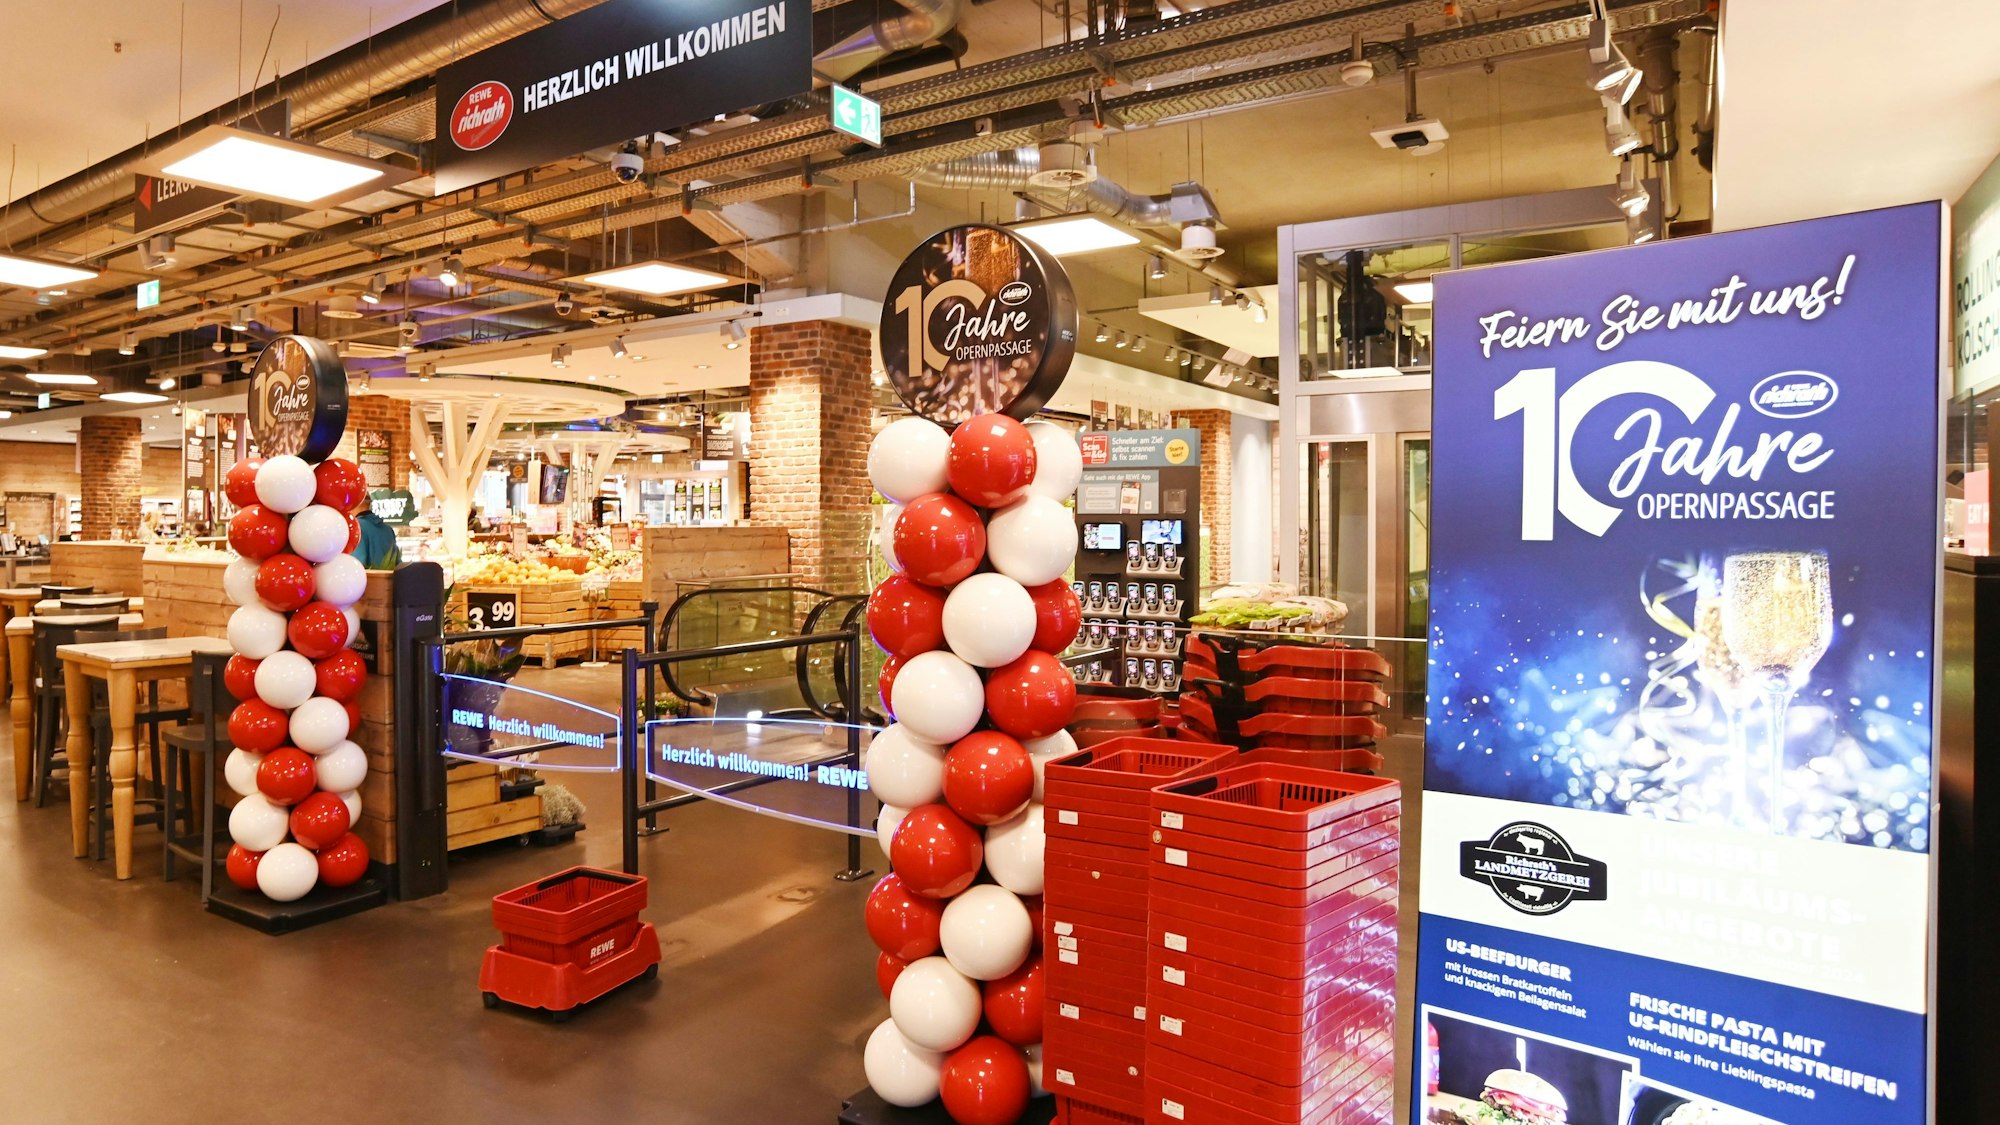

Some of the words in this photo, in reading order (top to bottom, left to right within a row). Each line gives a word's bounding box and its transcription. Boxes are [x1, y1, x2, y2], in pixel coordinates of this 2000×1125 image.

[523, 55, 620, 114] HERZLICH
[624, 1, 786, 80] WILLKOMMEN
[457, 96, 506, 134] richrath
[469, 87, 493, 105] REWE
[157, 178, 196, 203] LEER
[895, 279, 987, 378] 10
[943, 298, 1031, 351] Jahre
[1479, 310, 1592, 358] Feiern
[1596, 295, 1666, 351] Sie
[1666, 274, 1748, 330] mit
[1749, 254, 1856, 321] uns!
[955, 338, 1032, 361] OPERNPASSAGE
[254, 370, 292, 431] 10
[273, 384, 309, 416] Jahre
[1494, 360, 1717, 541] 10
[1608, 402, 1835, 499] Jahre
[1637, 491, 1835, 520] OPERNPASSAGE
[452, 708, 484, 729] REWE
[488, 714, 531, 737] Herzlich
[533, 722, 605, 750] willkommen!
[661, 743, 715, 768] Herzlich
[717, 752, 809, 782] willkommen!
[817, 765, 870, 791] REWE
[1474, 858, 1591, 889] LANDMETZGEREI
[1504, 855, 1558, 873] Richrath's
[590, 938, 615, 959] REWE
[1445, 937, 1572, 982] US-BEEFBURGER
[1444, 961, 1462, 973] mit
[1462, 963, 1501, 983] krossen
[1501, 974, 1573, 1002] Bratkartoffeln
[1444, 972, 1464, 985] und
[1464, 977, 1517, 998] knackigem
[1517, 990, 1587, 1019] Beilagensalat
[1629, 991, 1707, 1026] FRISCHE
[1710, 1012, 1778, 1046] PASTA
[1782, 1031, 1826, 1058] MIT
[1627, 1034, 1672, 1058] Wählen
[1673, 1048, 1692, 1064] sie
[1693, 1053, 1719, 1072] Ihre
[1720, 1061, 1816, 1100] Lieblingspasta
[1628, 1010, 1898, 1101] US-RINDFLEISCHSTREIFEN
